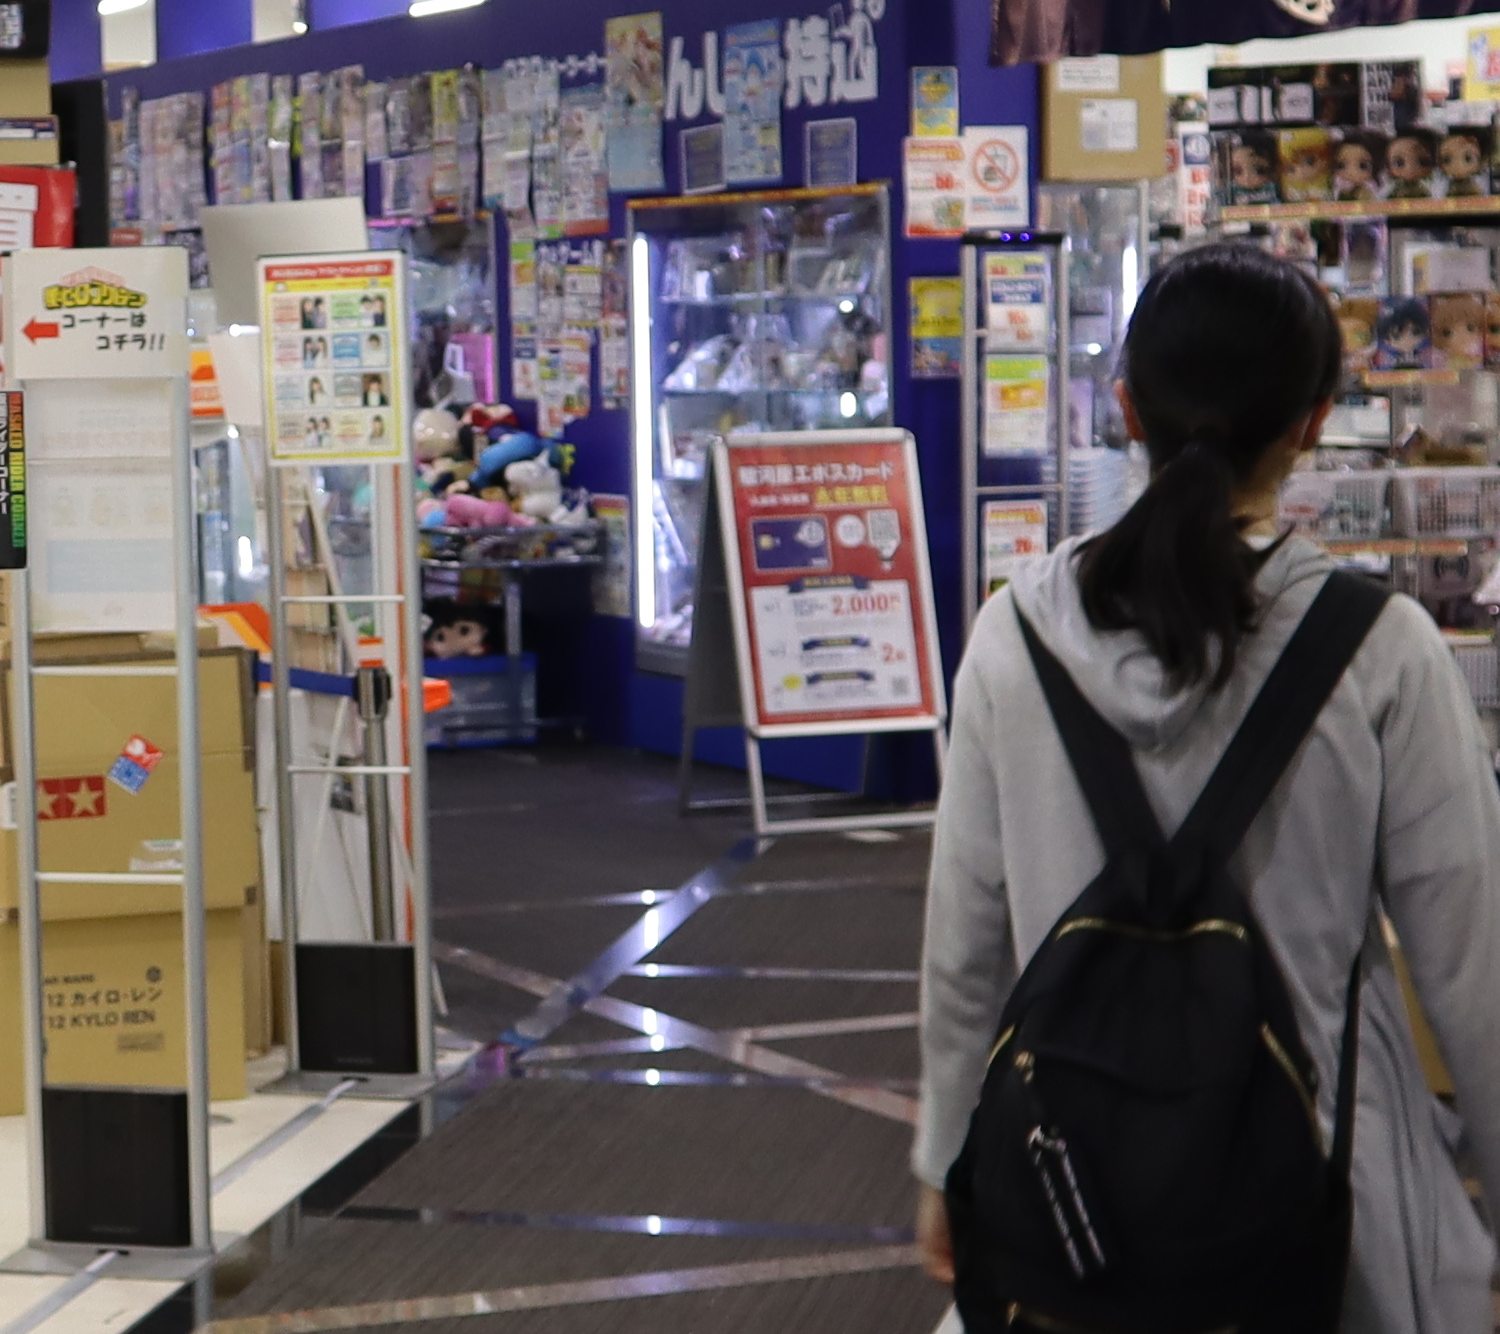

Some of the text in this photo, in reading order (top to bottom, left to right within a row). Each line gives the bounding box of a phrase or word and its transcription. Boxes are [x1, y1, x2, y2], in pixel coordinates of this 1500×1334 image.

[62, 313, 146, 329] コーナーは
[96, 333, 166, 351] コチラ!!
[9, 452, 25, 492] RIDER
[11, 494, 27, 548] CORNER
[70, 988, 162, 1007] カイロ・レン
[69, 1010, 119, 1028] KYLO
[121, 1008, 156, 1025] REN
